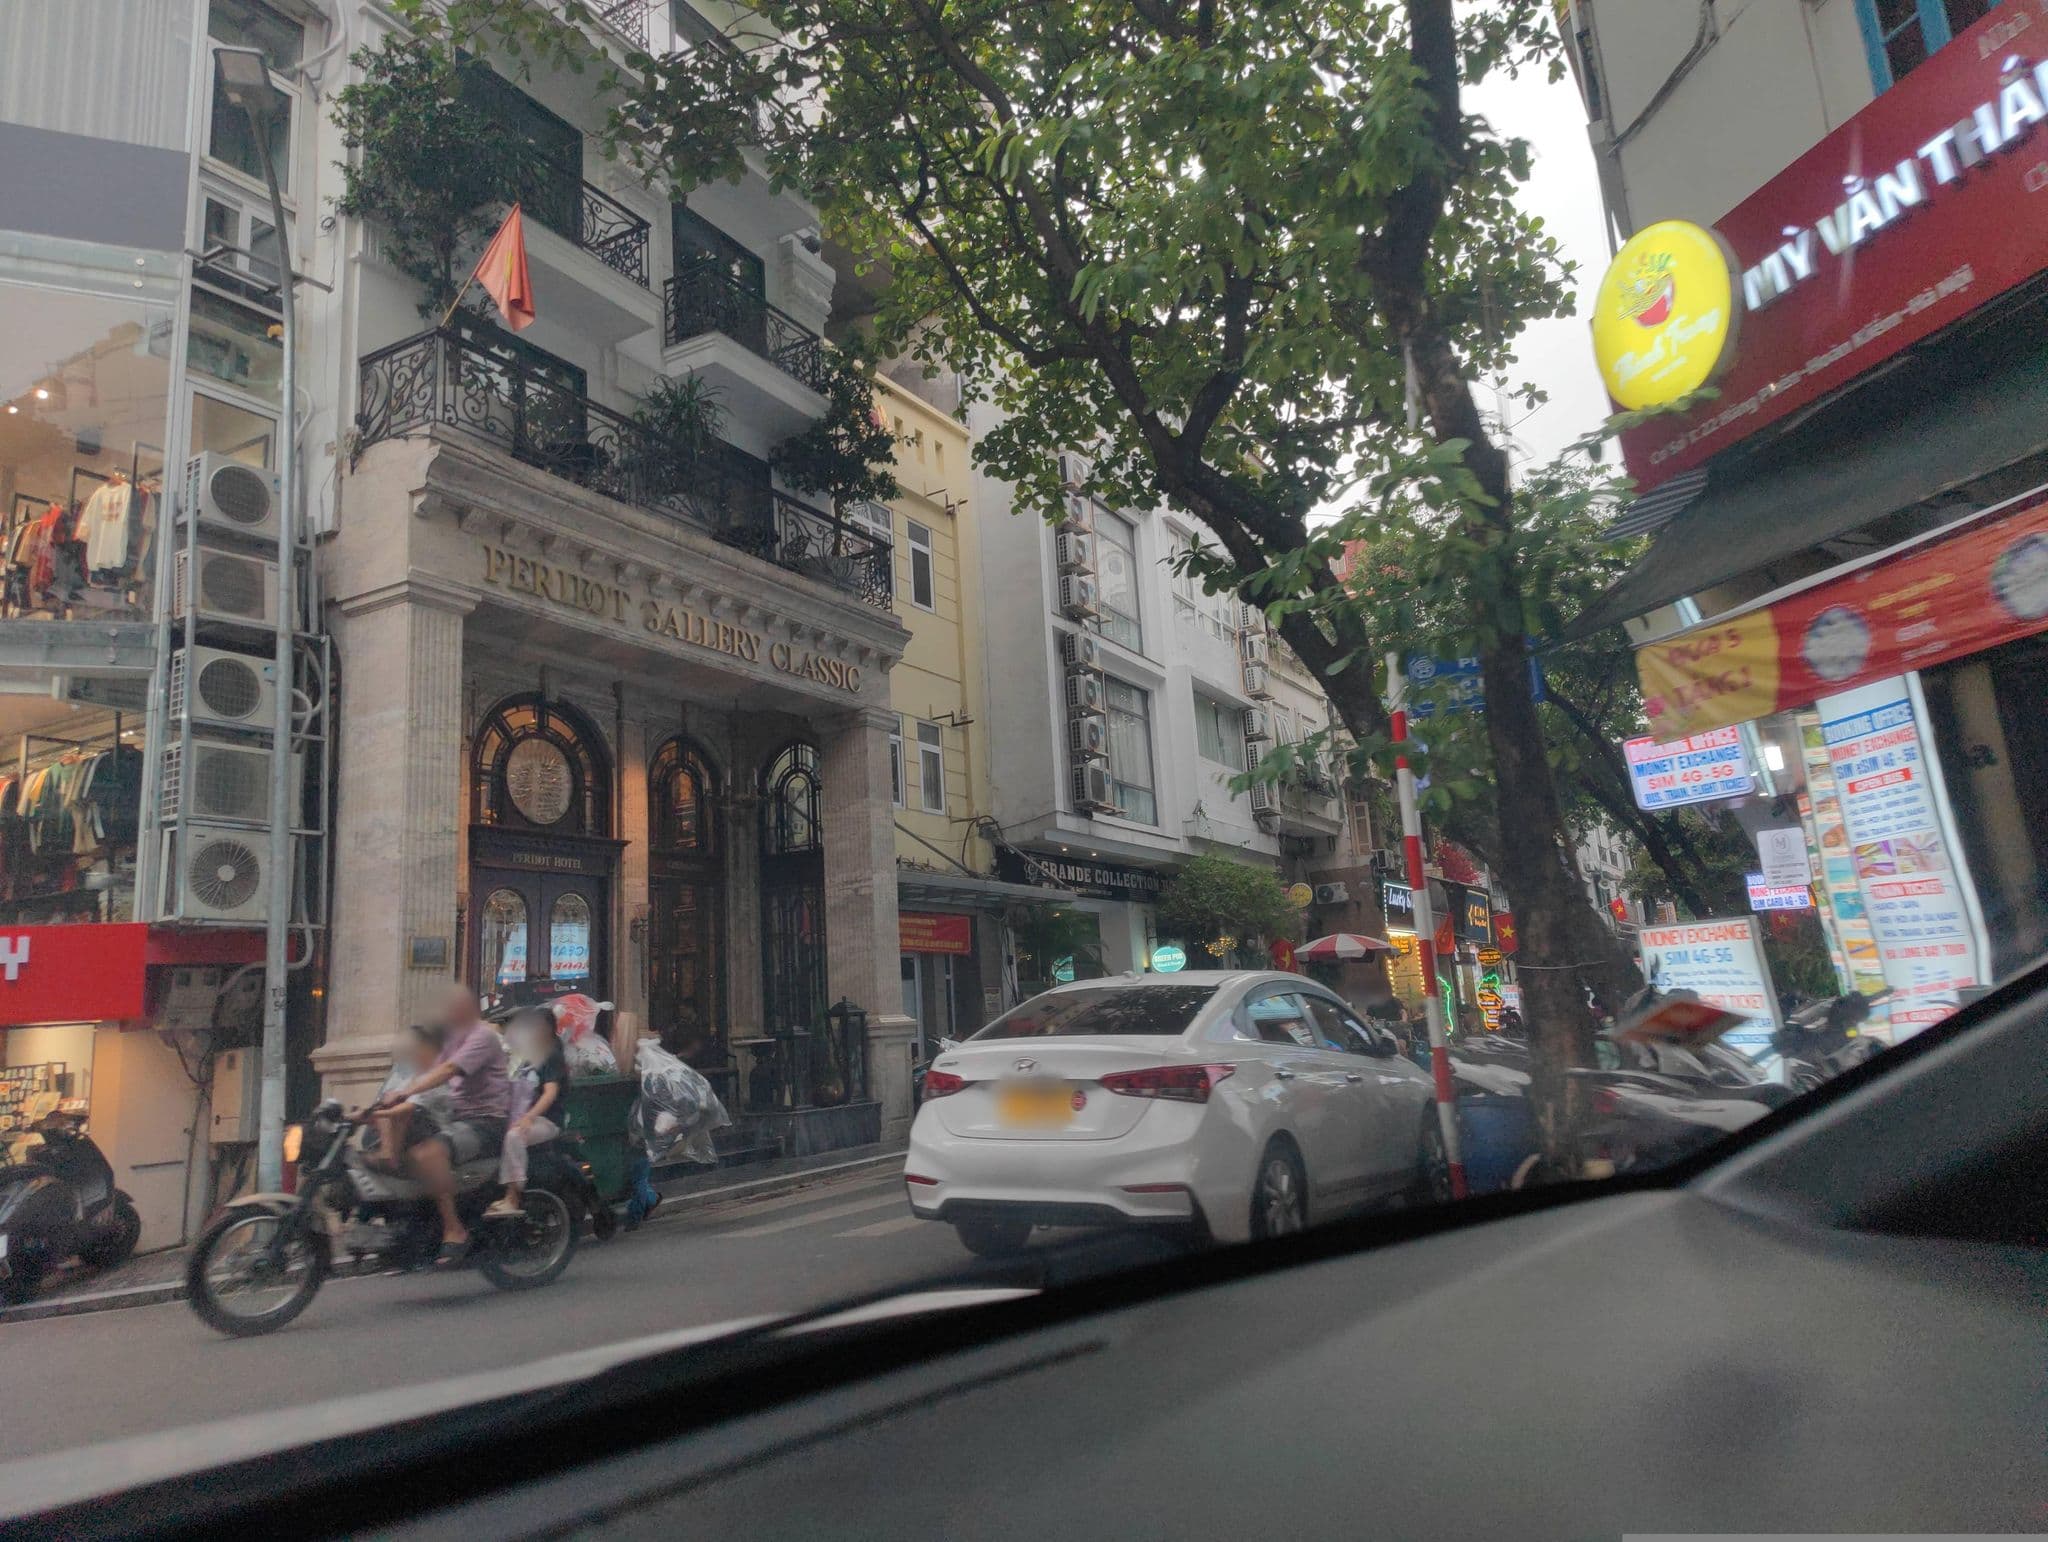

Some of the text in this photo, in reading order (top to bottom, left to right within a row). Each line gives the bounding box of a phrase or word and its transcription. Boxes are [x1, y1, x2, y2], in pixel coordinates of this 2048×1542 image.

[640, 598, 762, 665] GALLERY
[769, 640, 864, 695] CLASSIC
[1634, 745, 1742, 777] MONEY EXCHANGE
[1647, 774, 1677, 790] SIM
[553, 855, 583, 869] HOTEL
[1039, 859, 1092, 884] GRANDE
[1643, 923, 1751, 947] MONEY EXCHANGE
[1665, 949, 1690, 966] SIM
